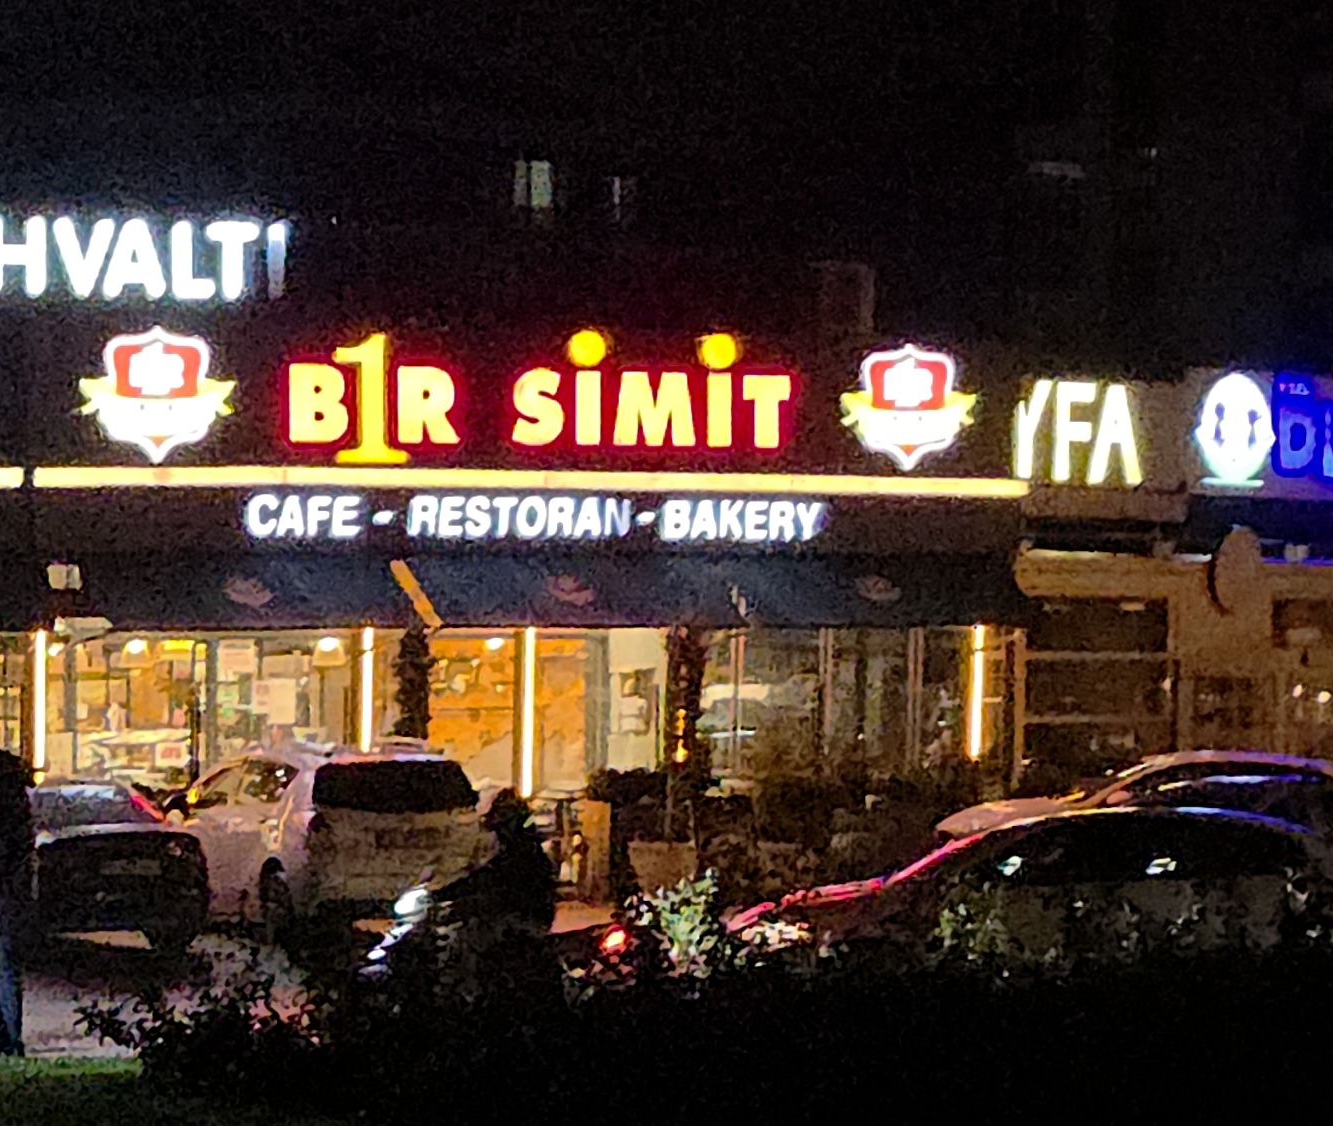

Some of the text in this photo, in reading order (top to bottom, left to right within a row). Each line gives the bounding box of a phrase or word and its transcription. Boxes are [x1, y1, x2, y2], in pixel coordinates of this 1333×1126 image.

[245, 494, 362, 538] CAFE
[406, 495, 631, 540] RESTORAN
[660, 499, 823, 542] BAKERY
